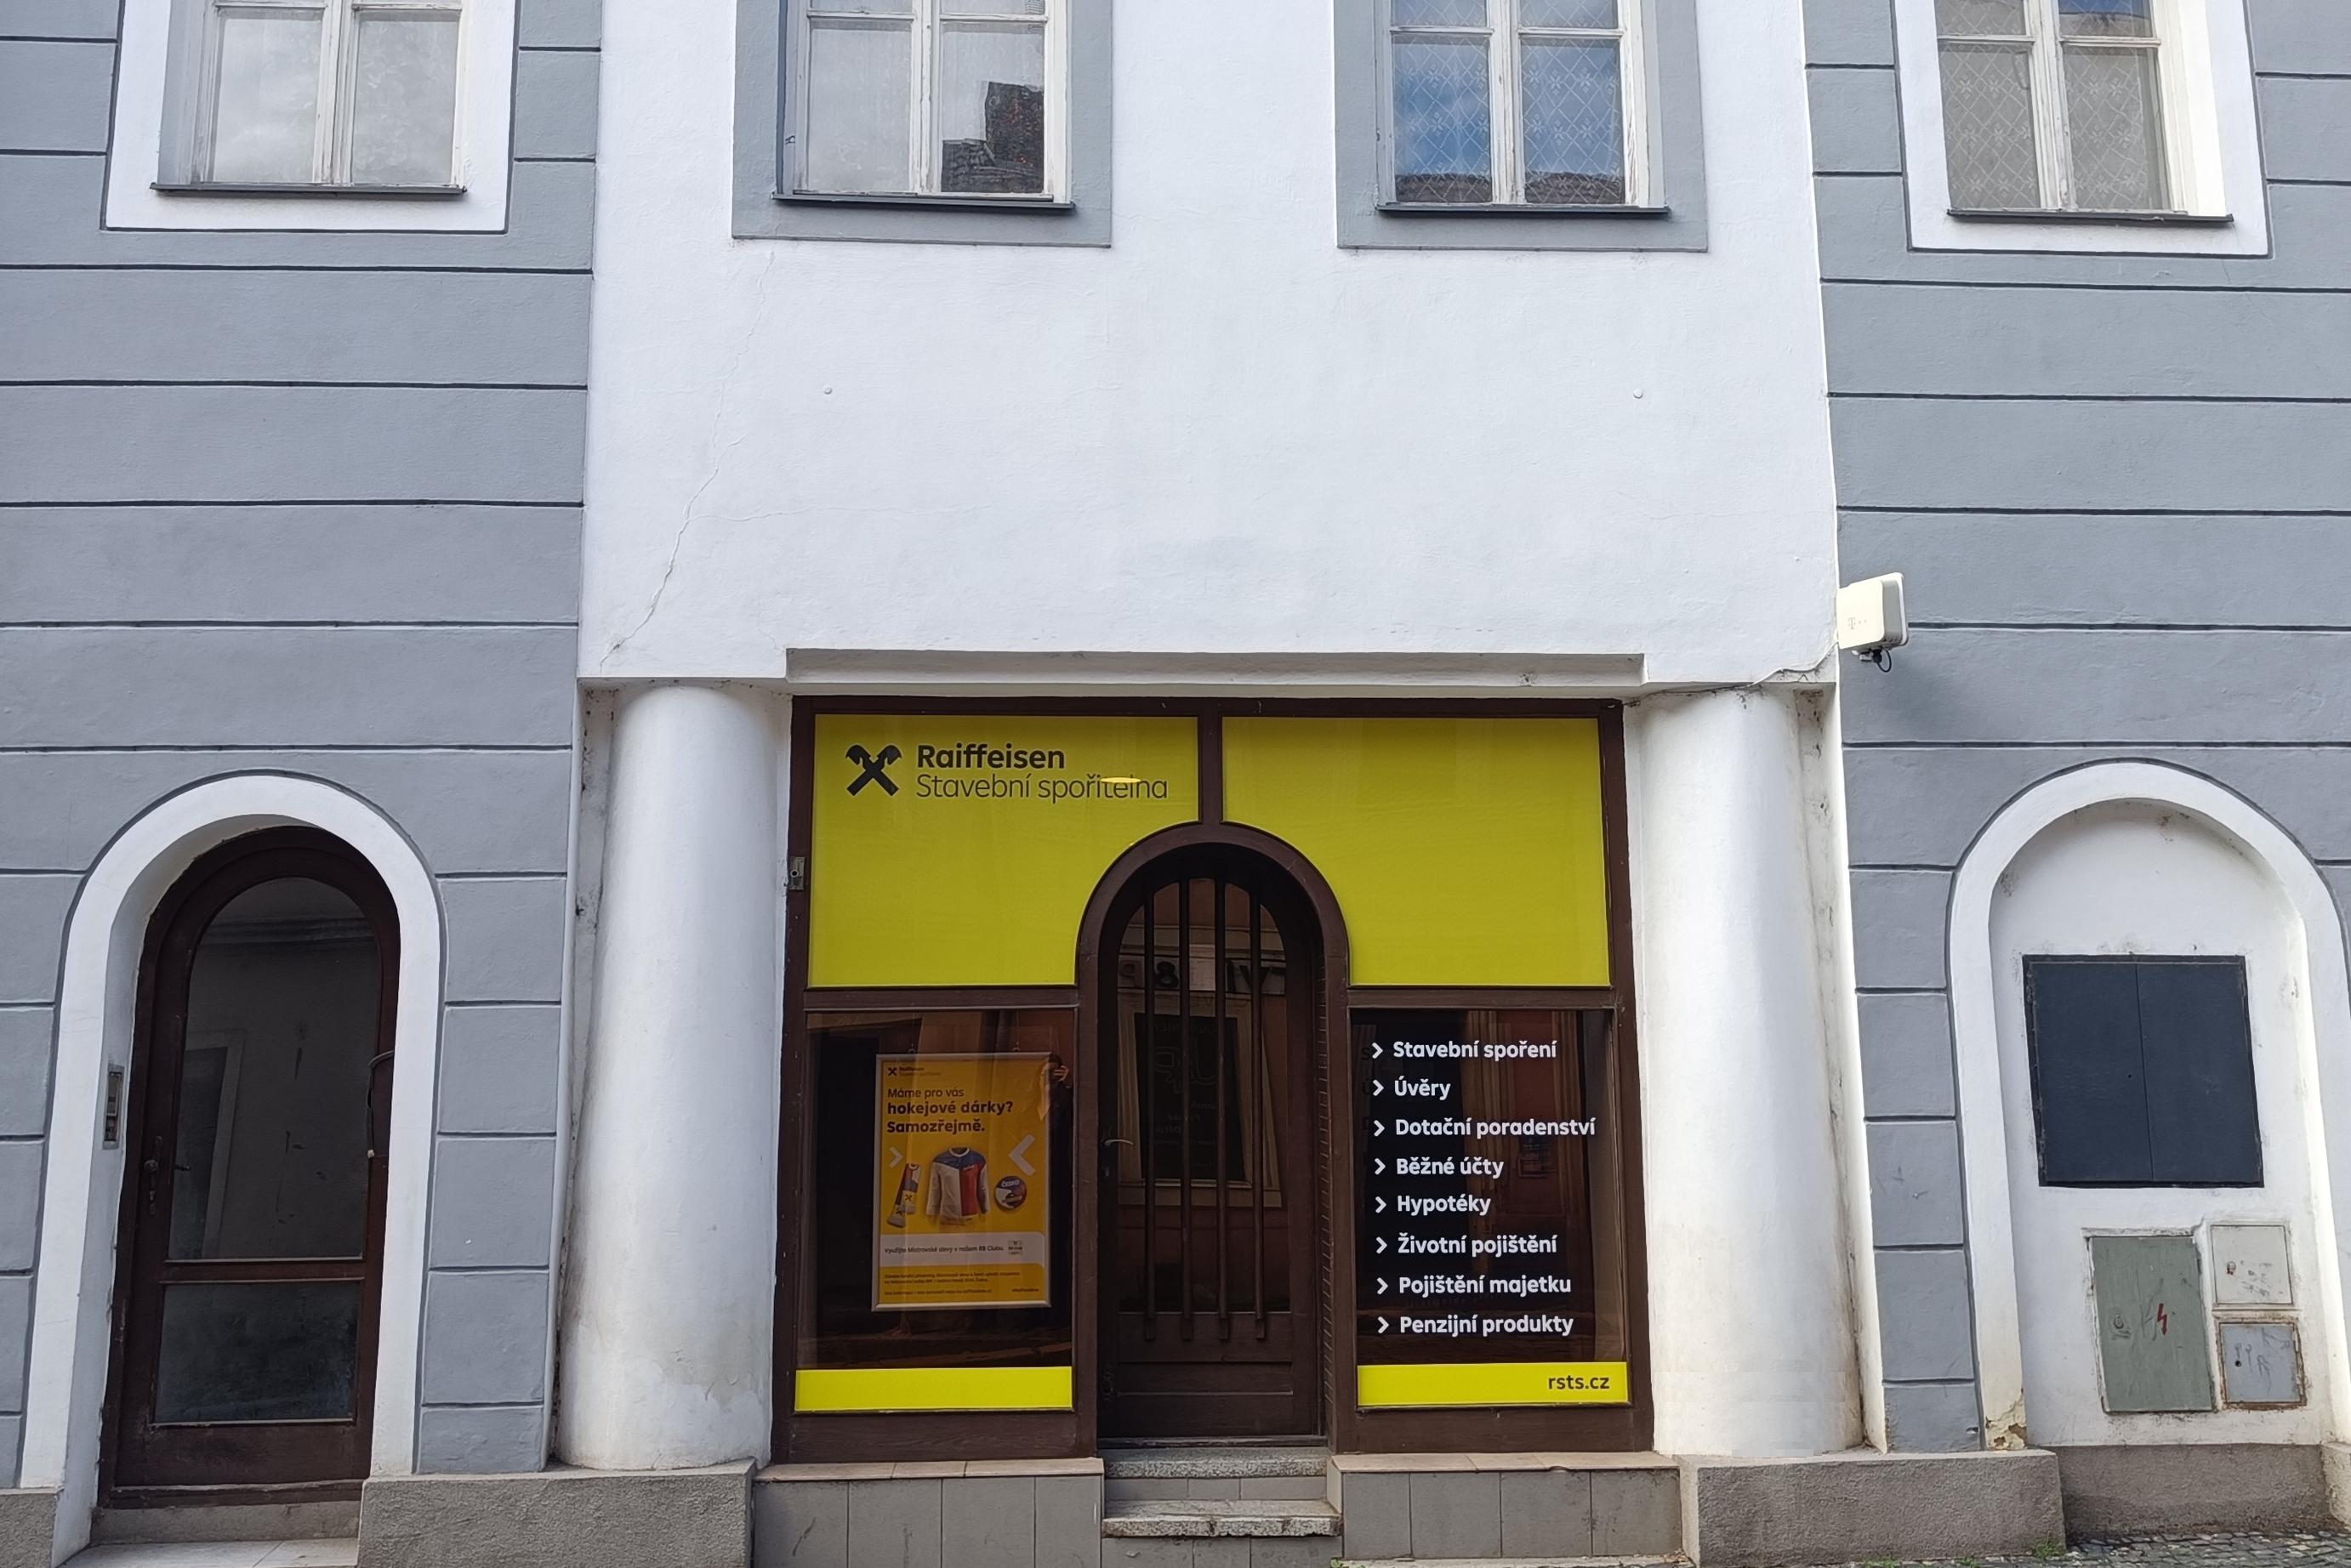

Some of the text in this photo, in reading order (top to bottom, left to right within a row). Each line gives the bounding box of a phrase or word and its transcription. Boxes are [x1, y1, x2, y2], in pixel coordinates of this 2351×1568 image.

[917, 742, 1065, 769] Raiffeisen
[916, 773, 1168, 804] Stavební spořitelna
[1392, 1040, 1557, 1061] Stavební spoření
[887, 1088, 965, 1100] Máme pro vás
[1393, 1075, 1451, 1100] Úvěry
[887, 1100, 1014, 1117] hokejové dárky?
[886, 1118, 985, 1135] Samozřejmě.
[1395, 1117, 1597, 1139] Dotační poradenství
[1396, 1156, 1505, 1179] Běžné účty
[1397, 1194, 1492, 1216] Hypotéky
[1398, 1232, 1558, 1258] Životní pojištění
[1398, 1275, 1572, 1298] Pojištění majetku
[1399, 1314, 1574, 1338] Penzijní produkty
[1548, 1374, 1610, 1391] rsts.cz
